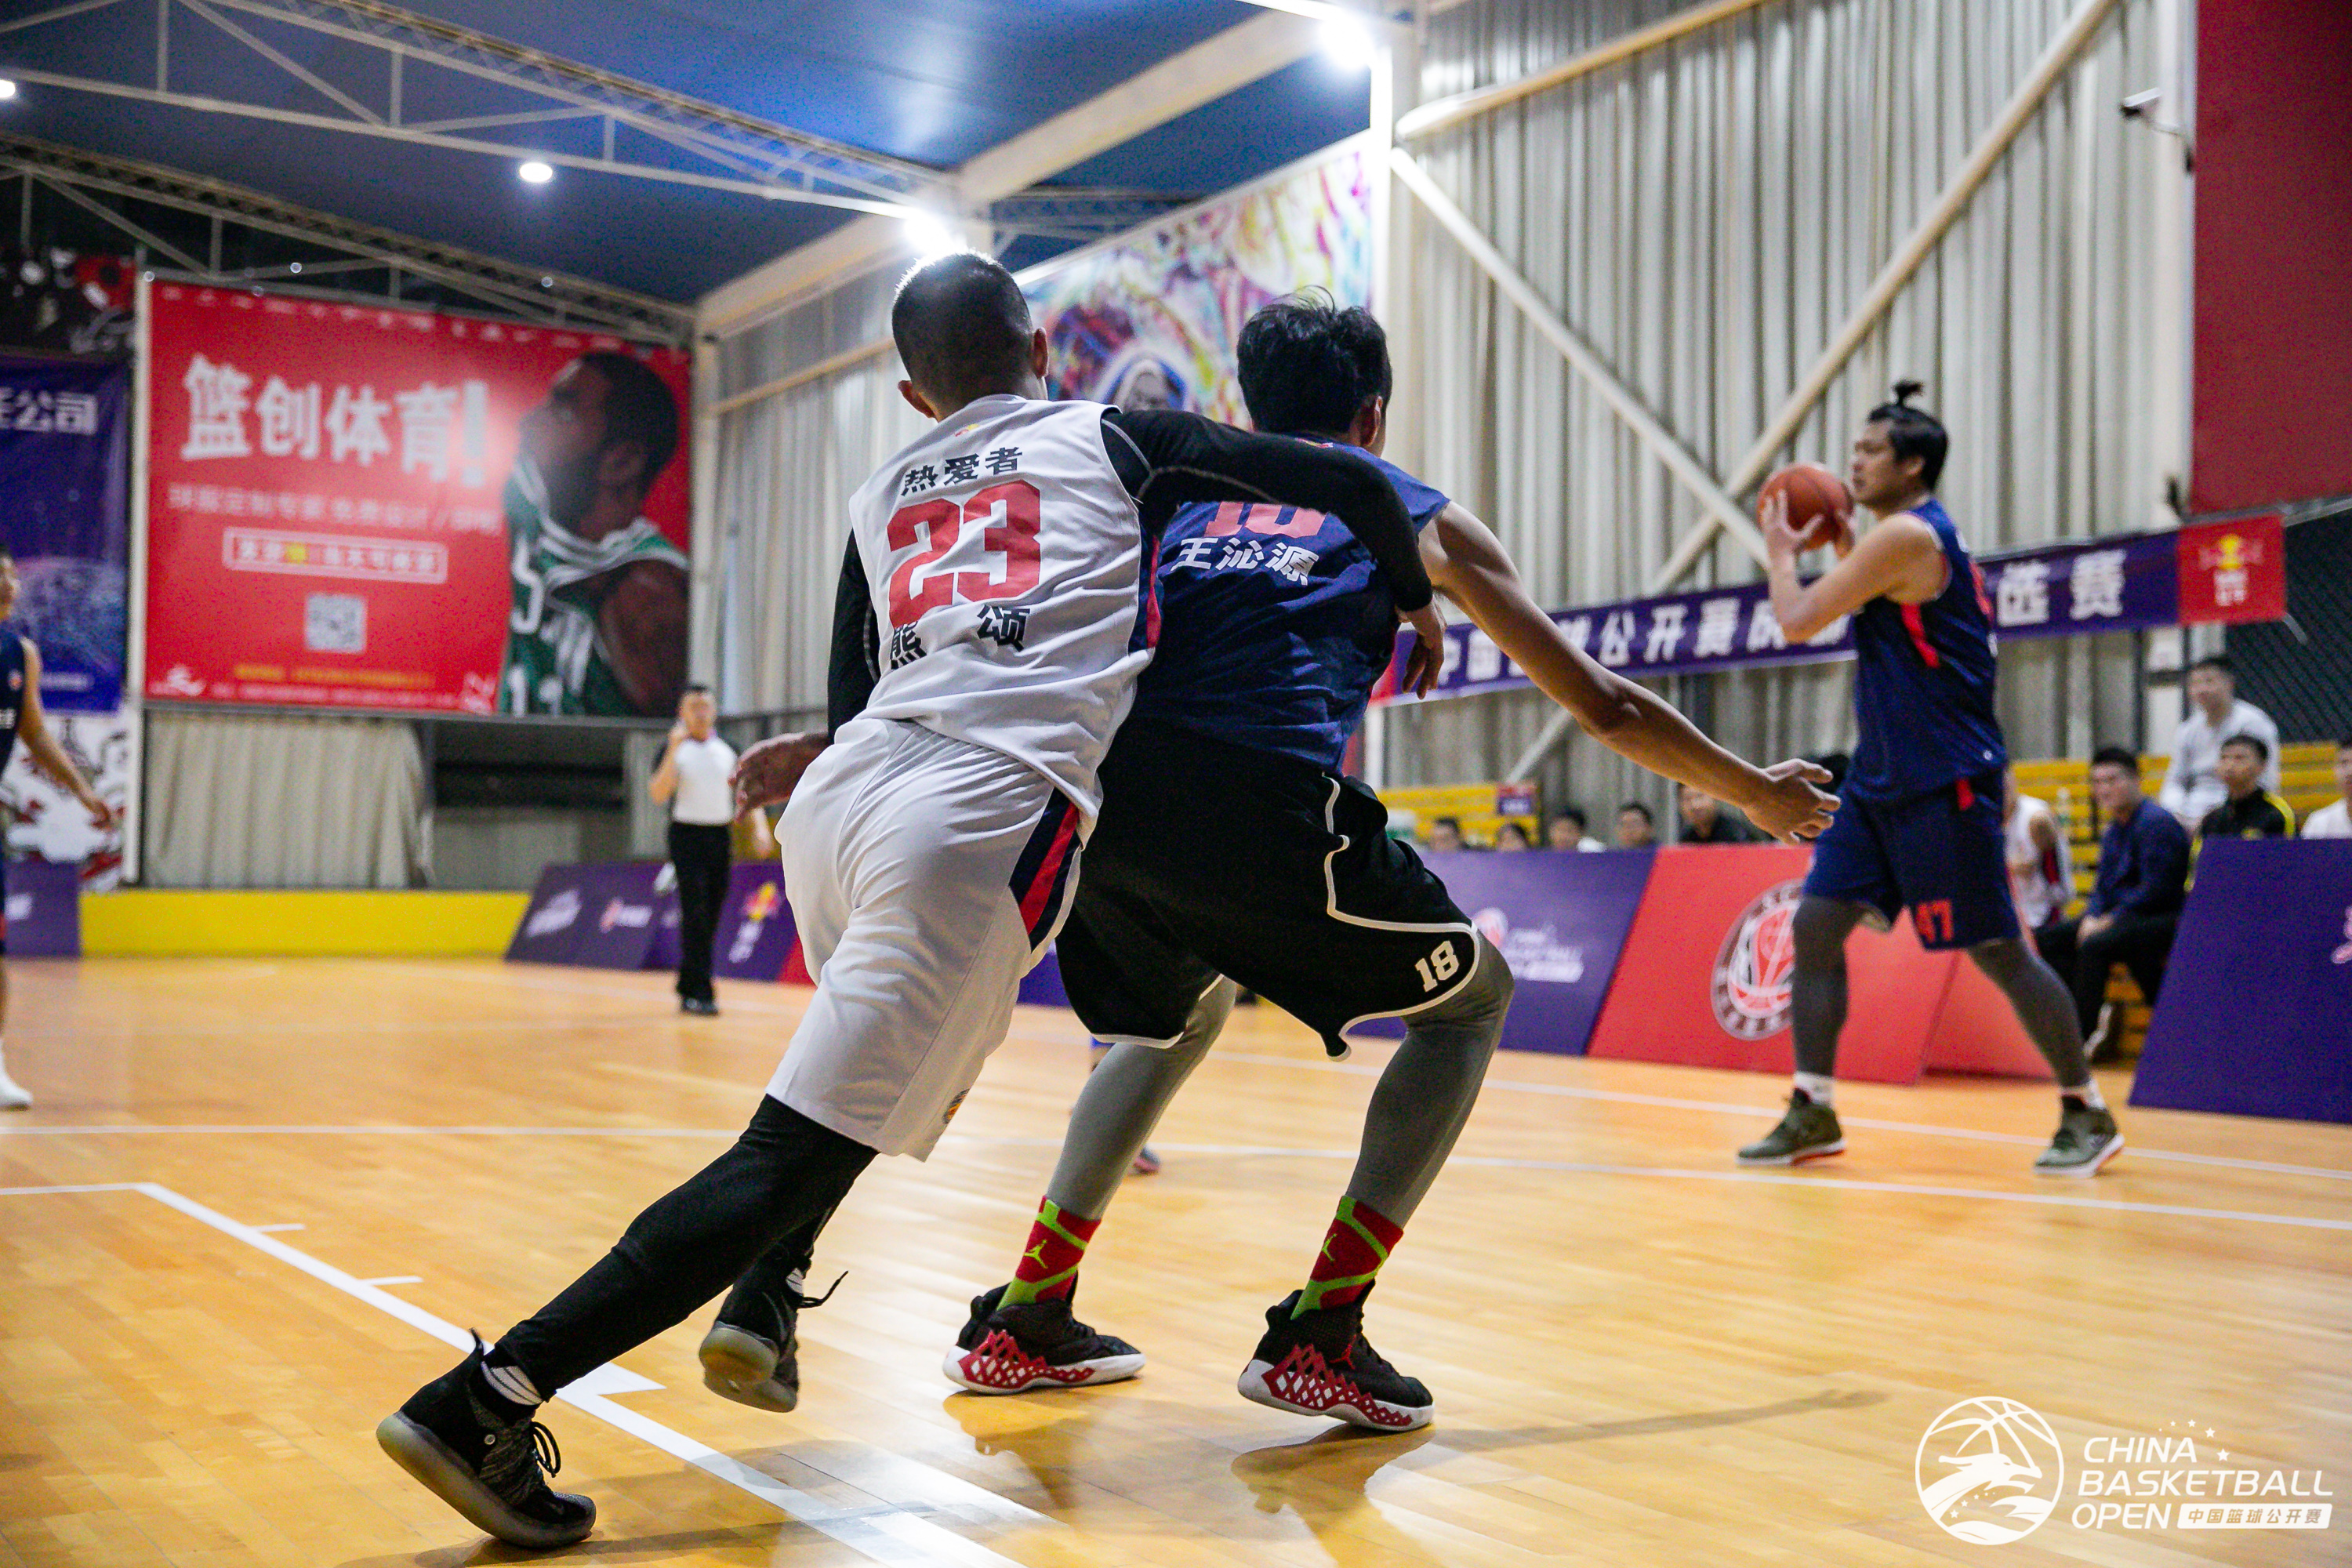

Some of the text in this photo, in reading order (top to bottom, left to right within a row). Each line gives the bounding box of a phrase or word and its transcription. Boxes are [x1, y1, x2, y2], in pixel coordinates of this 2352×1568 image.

[902, 446, 1022, 496] 热爱者
[887, 480, 1041, 630] 23
[1171, 537, 1320, 586] 王沁源
[1414, 940, 1460, 993] 18
